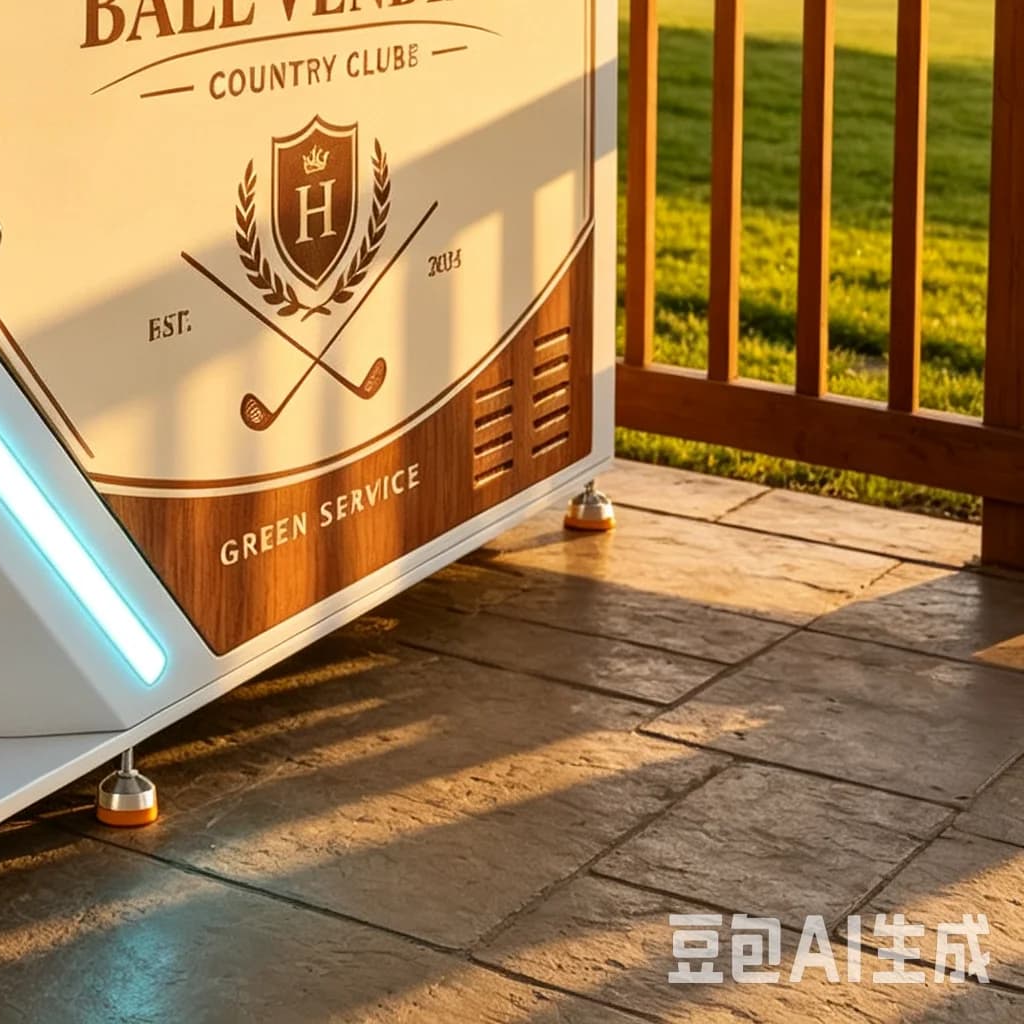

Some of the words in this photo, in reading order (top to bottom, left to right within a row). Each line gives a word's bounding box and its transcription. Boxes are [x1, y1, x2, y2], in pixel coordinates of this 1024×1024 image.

[209, 54, 337, 100] COUNTRY
[295, 178, 337, 244] H
[148, 310, 193, 342] EST.
[220, 511, 307, 566] GREEN
[319, 463, 421, 528] SERVICE
